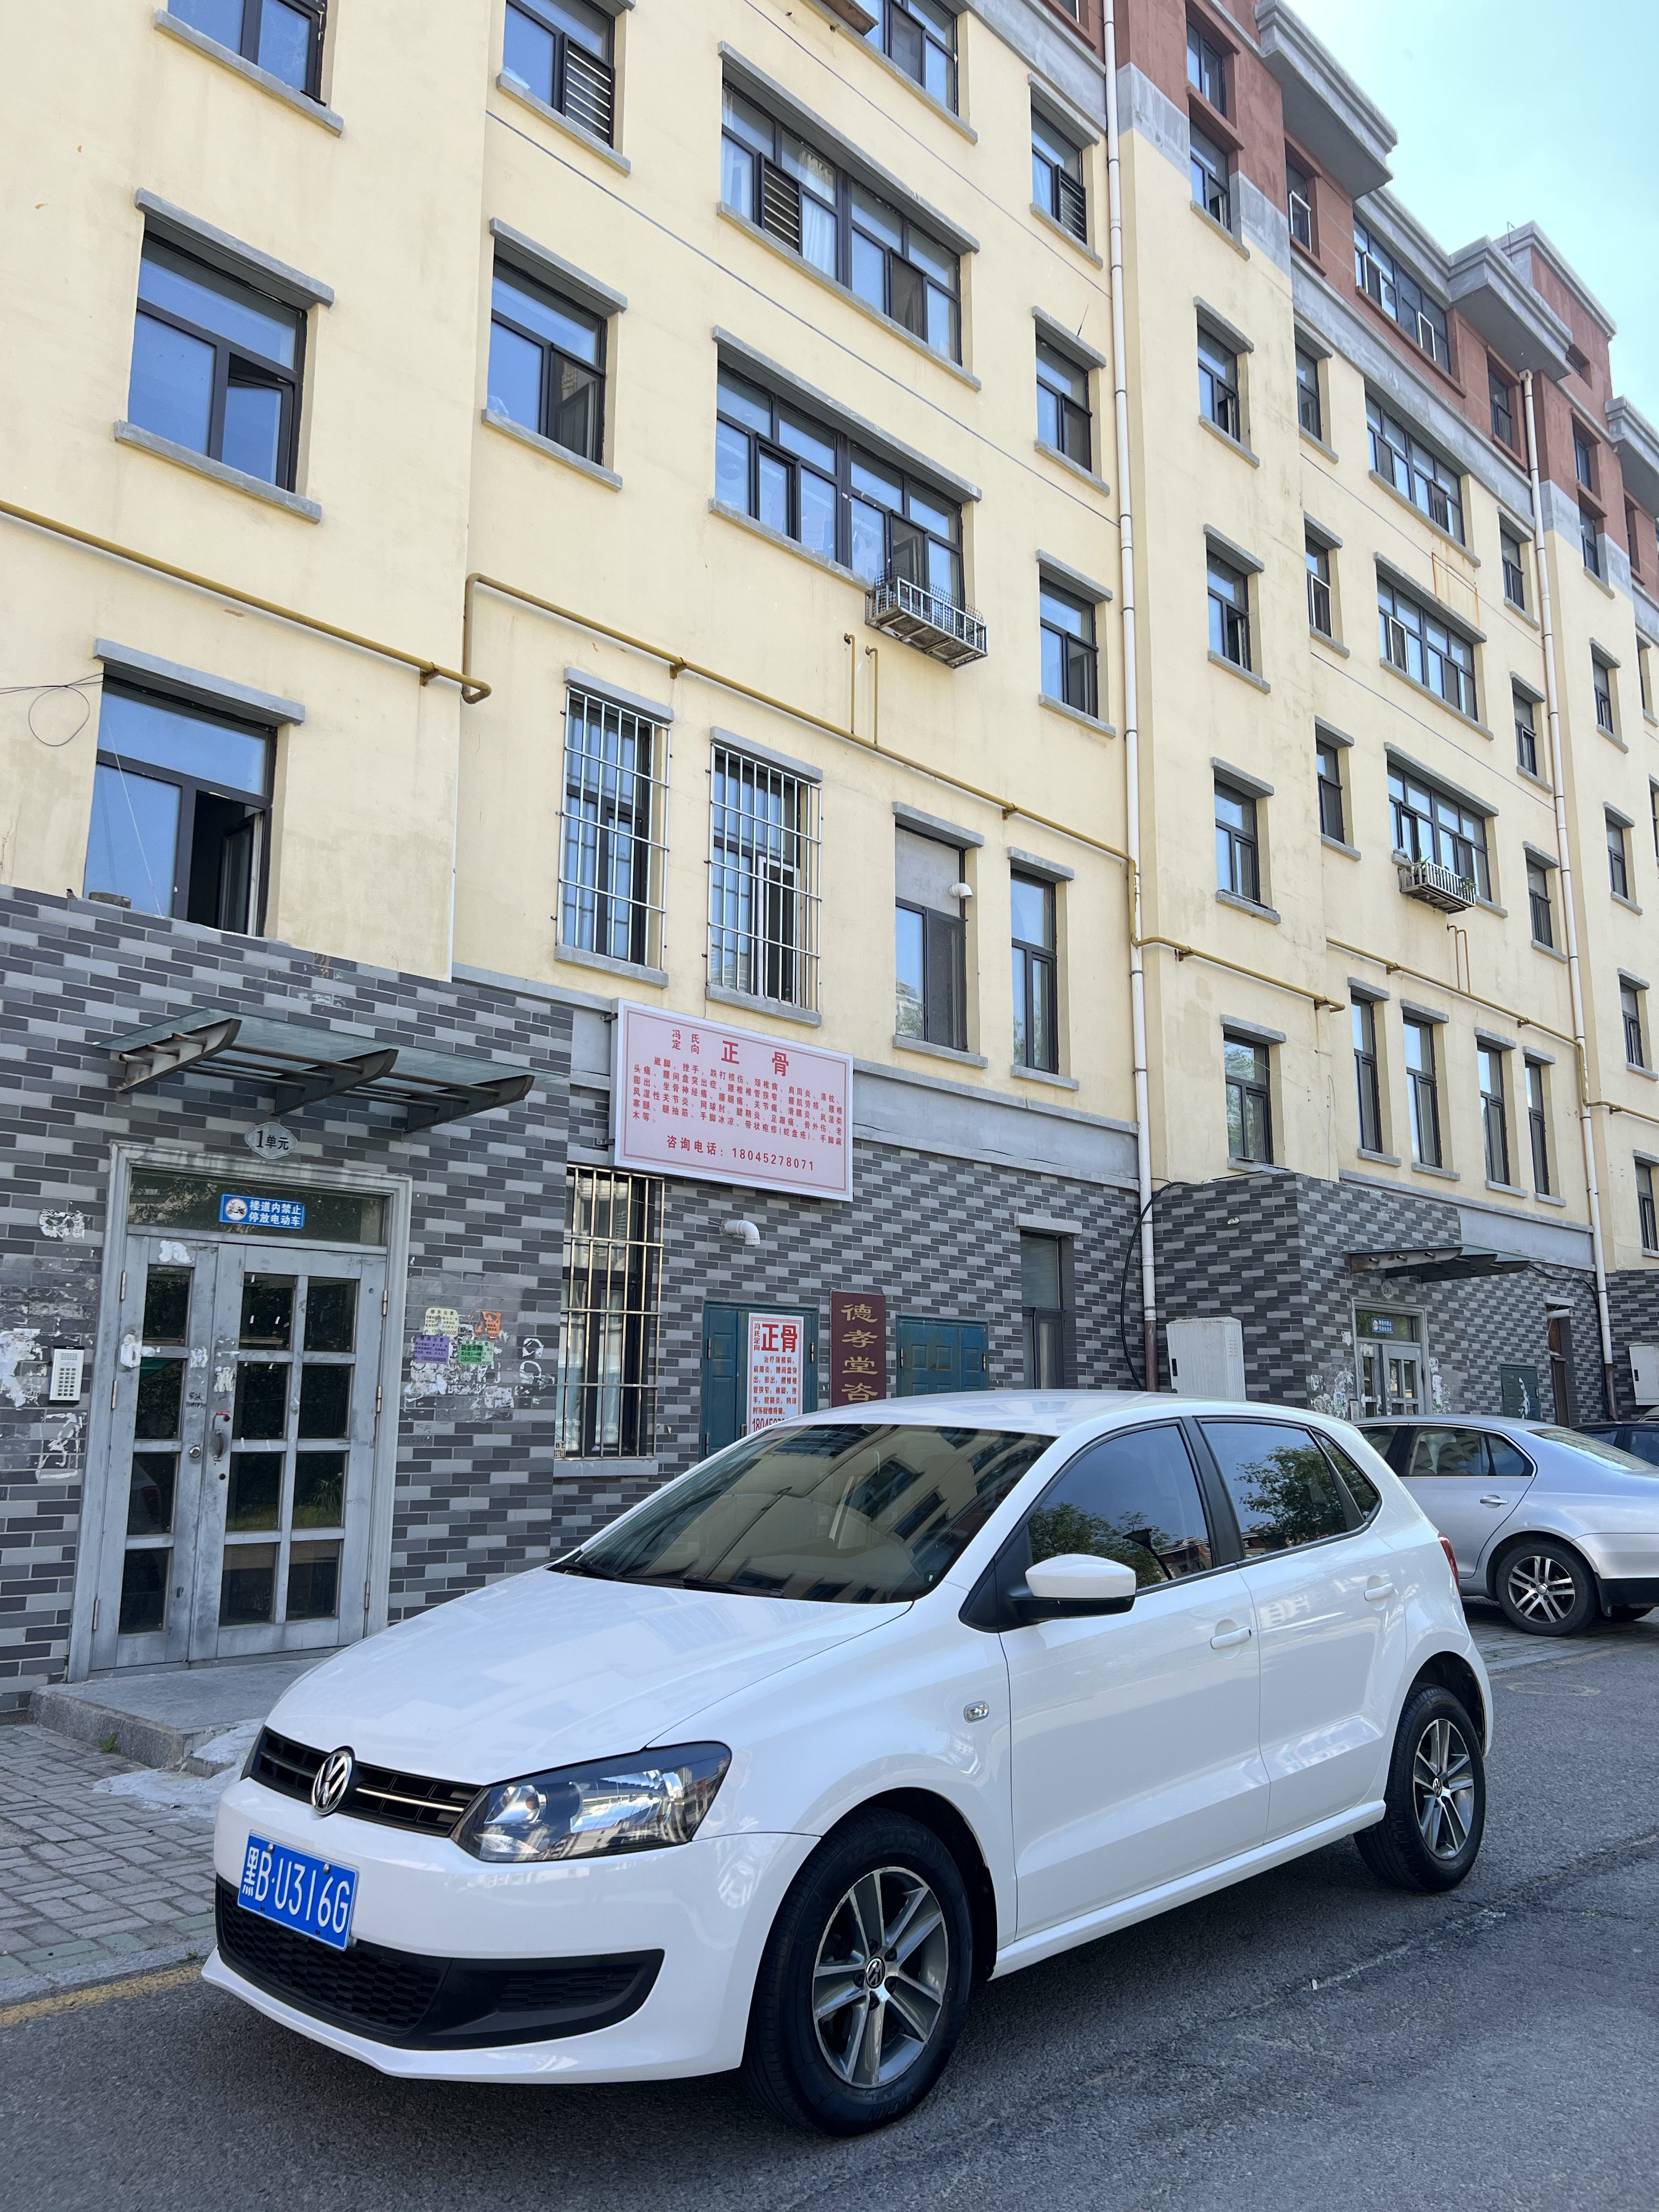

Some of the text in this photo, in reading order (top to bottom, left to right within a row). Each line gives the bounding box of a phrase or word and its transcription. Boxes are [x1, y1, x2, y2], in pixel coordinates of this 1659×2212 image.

[672, 1029, 699, 1044] 冯氏
[672, 1040, 699, 1054] 定向
[721, 1040, 789, 1076] 正骨
[256, 1130, 290, 1150] 1单元
[250, 1199, 302, 1215] 楼道内禁止
[249, 1212, 301, 1227] 停放电动车
[761, 1323, 798, 1353] 正骨
